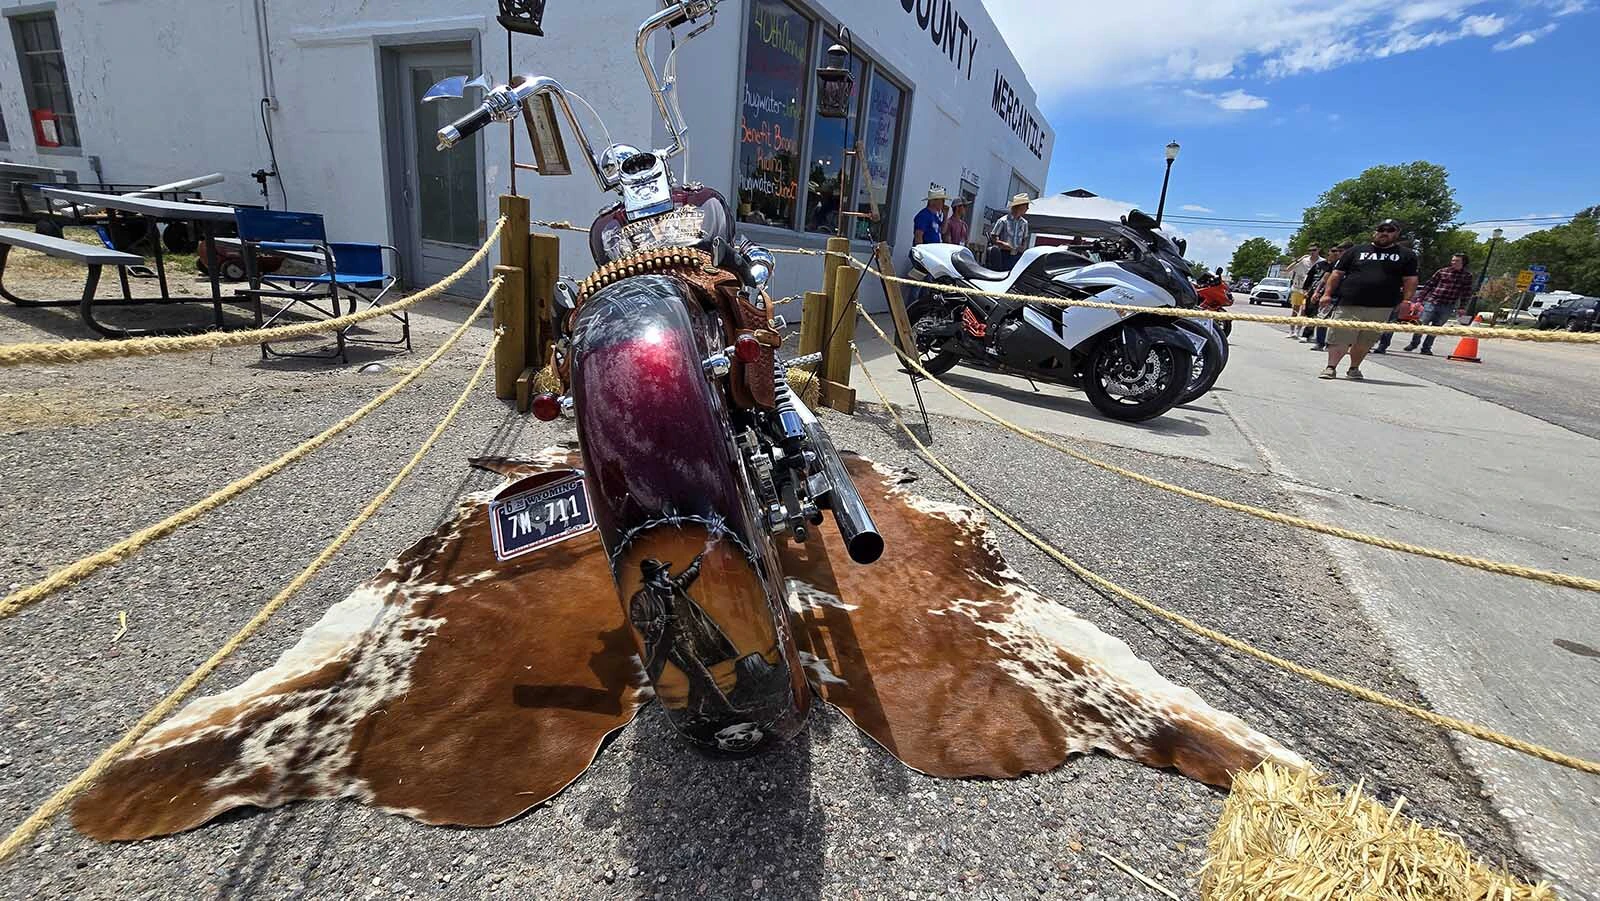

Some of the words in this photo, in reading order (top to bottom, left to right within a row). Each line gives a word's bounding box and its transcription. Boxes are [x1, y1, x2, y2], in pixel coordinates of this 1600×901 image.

[900, 0, 978, 80] OUNTY
[991, 69, 1046, 160] MERCANTILE
[1359, 251, 1400, 262] FAFO
[526, 481, 578, 505] WYOMING
